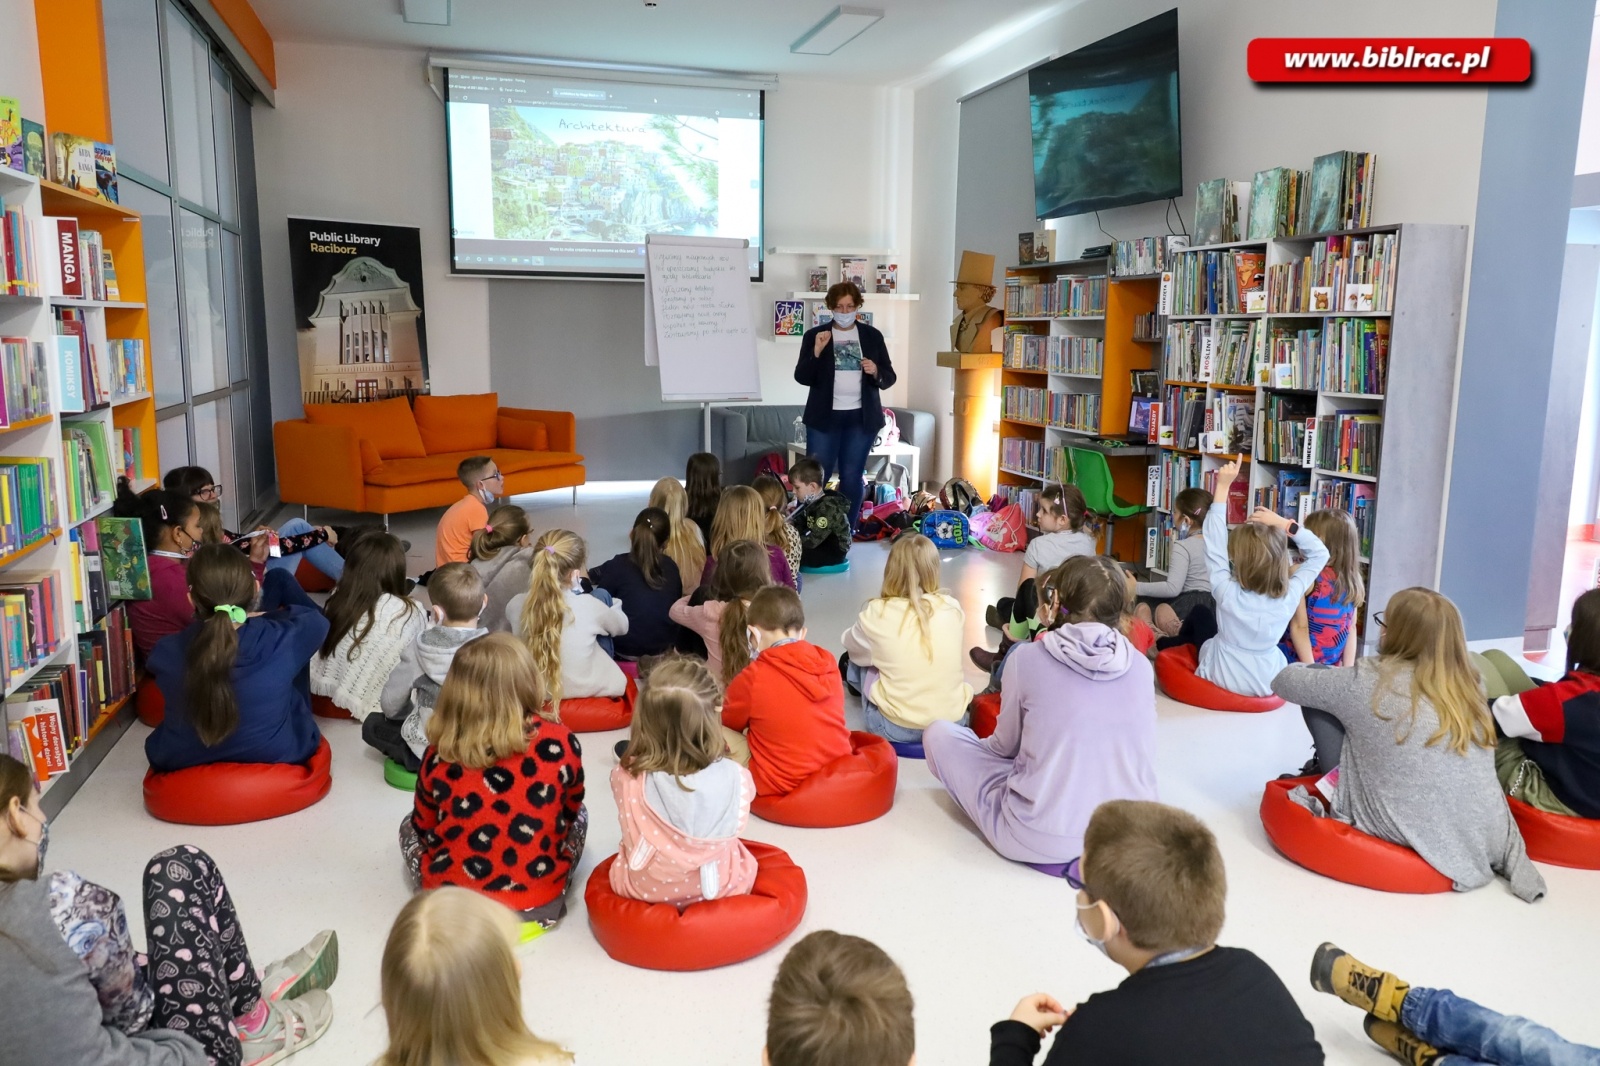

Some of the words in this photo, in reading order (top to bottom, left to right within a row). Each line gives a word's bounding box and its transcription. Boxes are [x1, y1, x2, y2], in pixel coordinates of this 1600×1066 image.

[558, 118, 647, 135] Architektura
[94, 147, 111, 156] STORIA
[309, 231, 343, 243] Public
[344, 234, 381, 247] Library
[310, 242, 357, 254] Raciborz
[61, 232, 76, 284] MANGA
[1203, 338, 1212, 370] ROŚLINY
[64, 350, 76, 398] KOMIKSY
[1306, 430, 1314, 465] MINECRAFT
[952, 516, 964, 545] GOL!
[49, 714, 57, 735] Wojny
[39, 721, 49, 747] historie
[44, 747, 53, 767] dzieci
[52, 735, 64, 767] dorosłych
